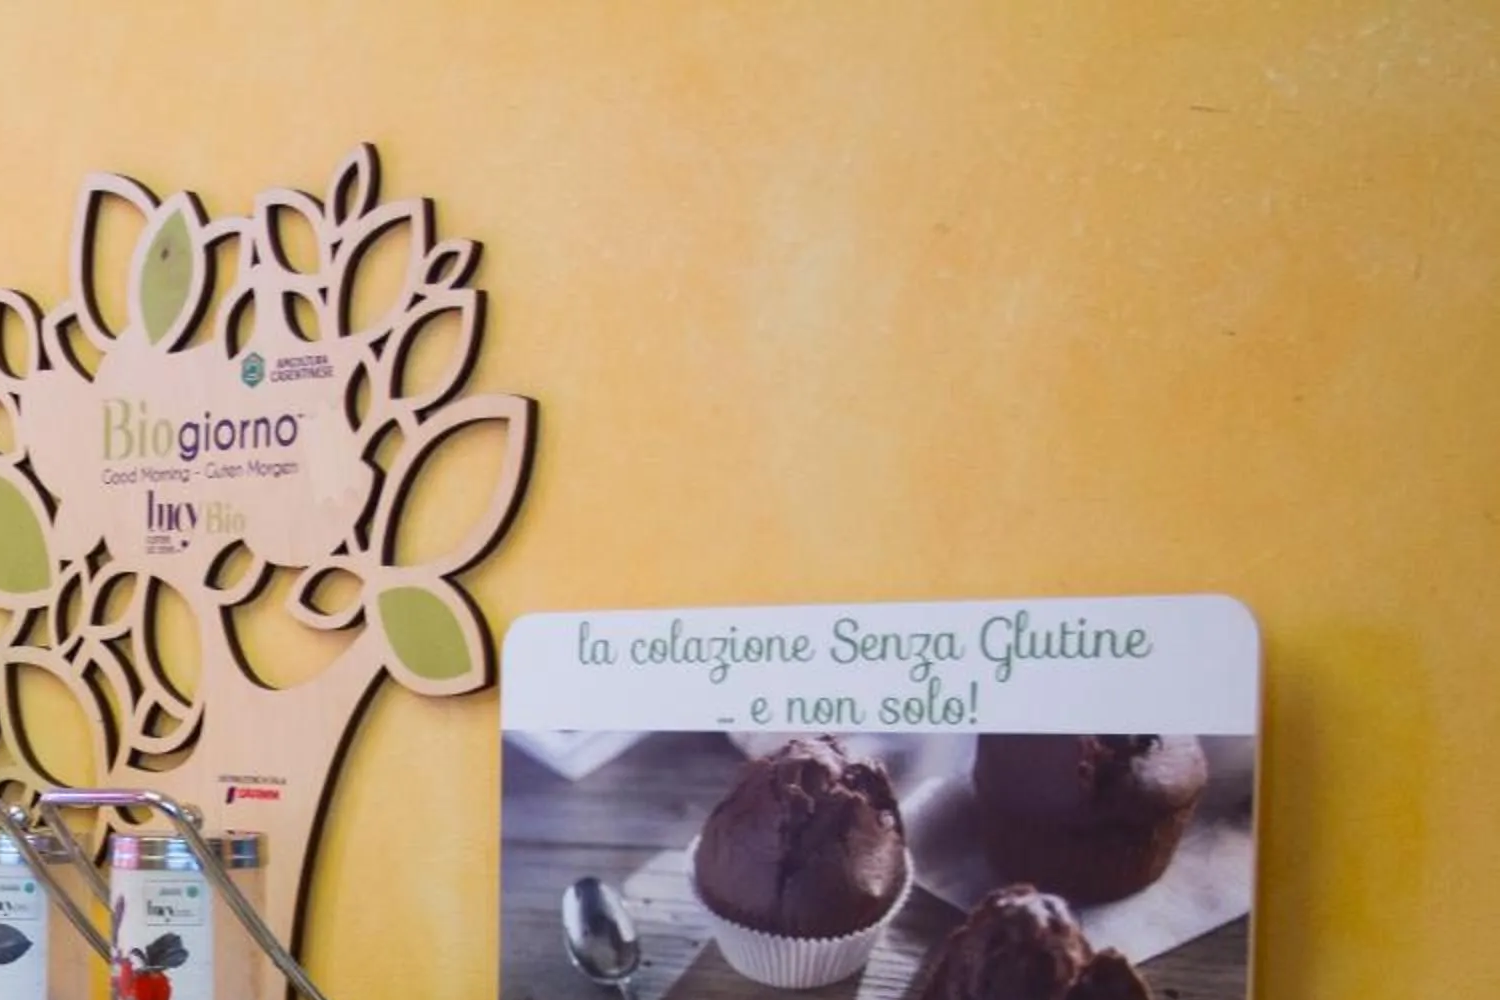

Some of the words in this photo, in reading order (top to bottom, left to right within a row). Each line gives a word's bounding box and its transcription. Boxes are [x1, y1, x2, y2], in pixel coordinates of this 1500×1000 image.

[101, 397, 299, 462] Biogiorno
[101, 466, 137, 485] Good
[141, 467, 190, 483] Morning
[248, 459, 299, 478] Morgen
[578, 620, 615, 666] la
[630, 617, 816, 685] colazione
[830, 616, 965, 682] Senza
[980, 609, 1153, 683] Glutine
[750, 696, 773, 725] e
[786, 695, 866, 726] non
[877, 676, 978, 726] solo!
